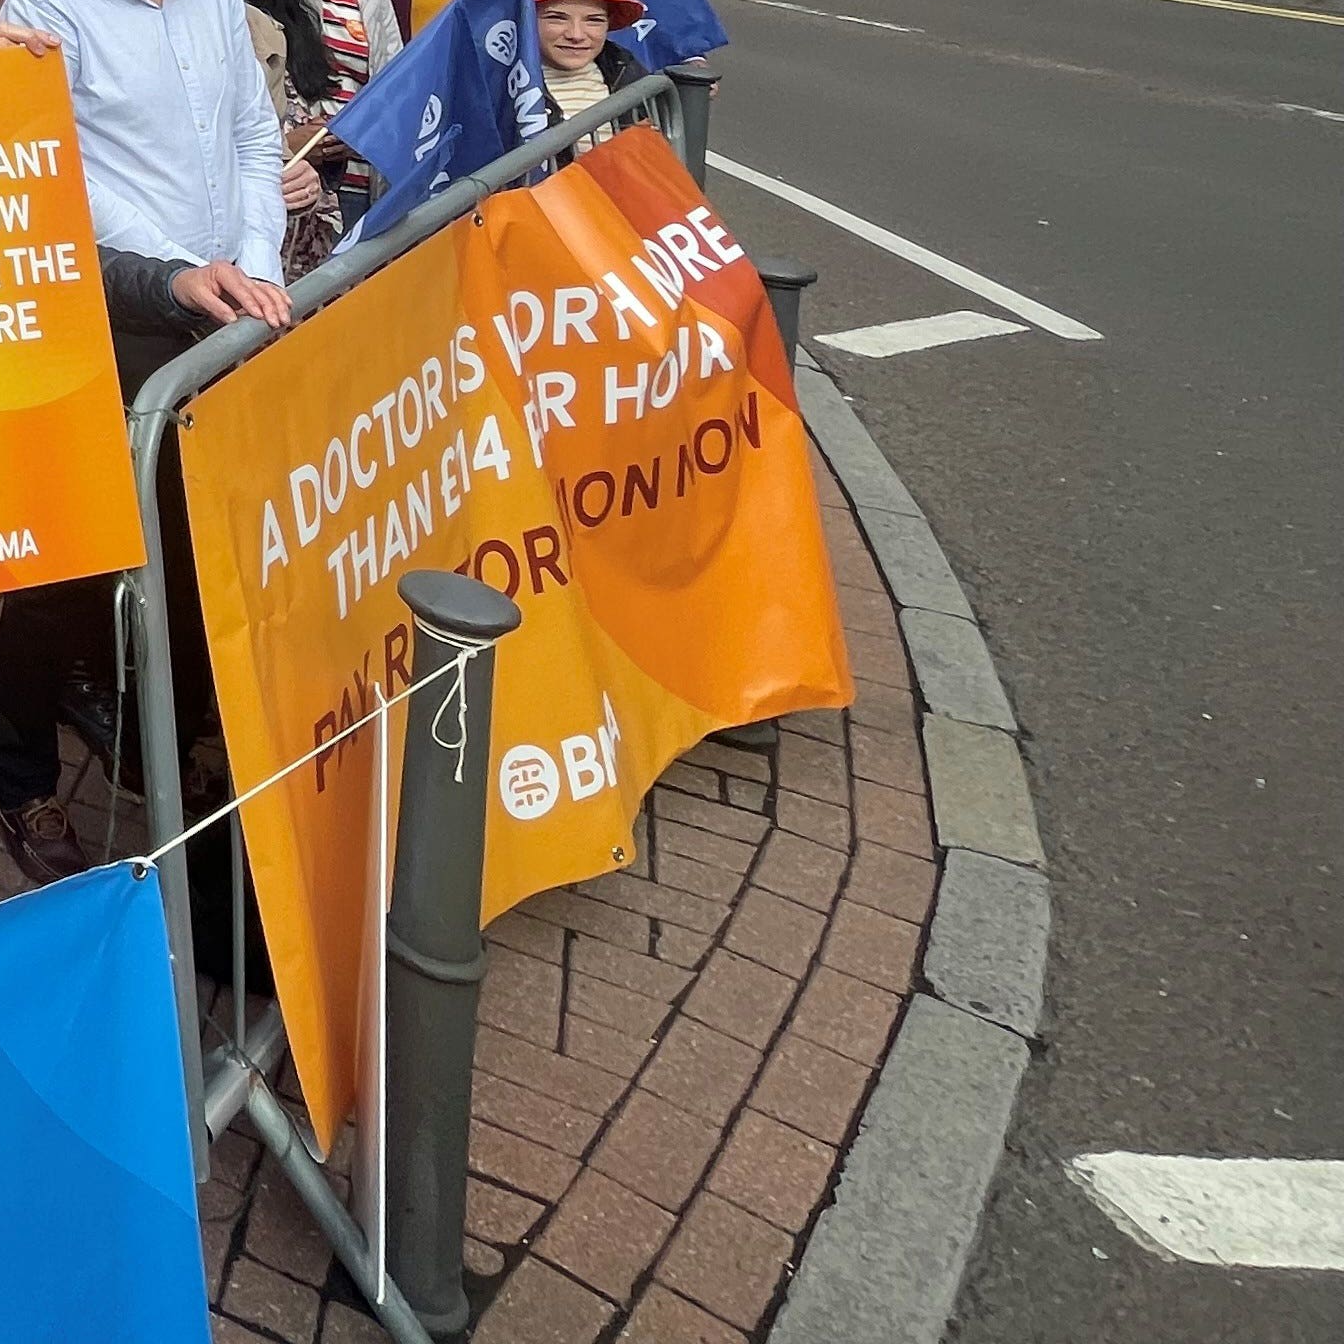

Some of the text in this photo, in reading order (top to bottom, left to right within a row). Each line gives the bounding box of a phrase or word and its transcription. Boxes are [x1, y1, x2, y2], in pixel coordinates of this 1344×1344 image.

[10, 241, 81, 284] THE
[261, 499, 289, 589] A
[289, 357, 447, 549] DOCTOR
[449, 324, 487, 403] IS
[493, 271, 658, 376] ORH
[327, 469, 434, 621] THAN
[441, 414, 512, 518] £14
